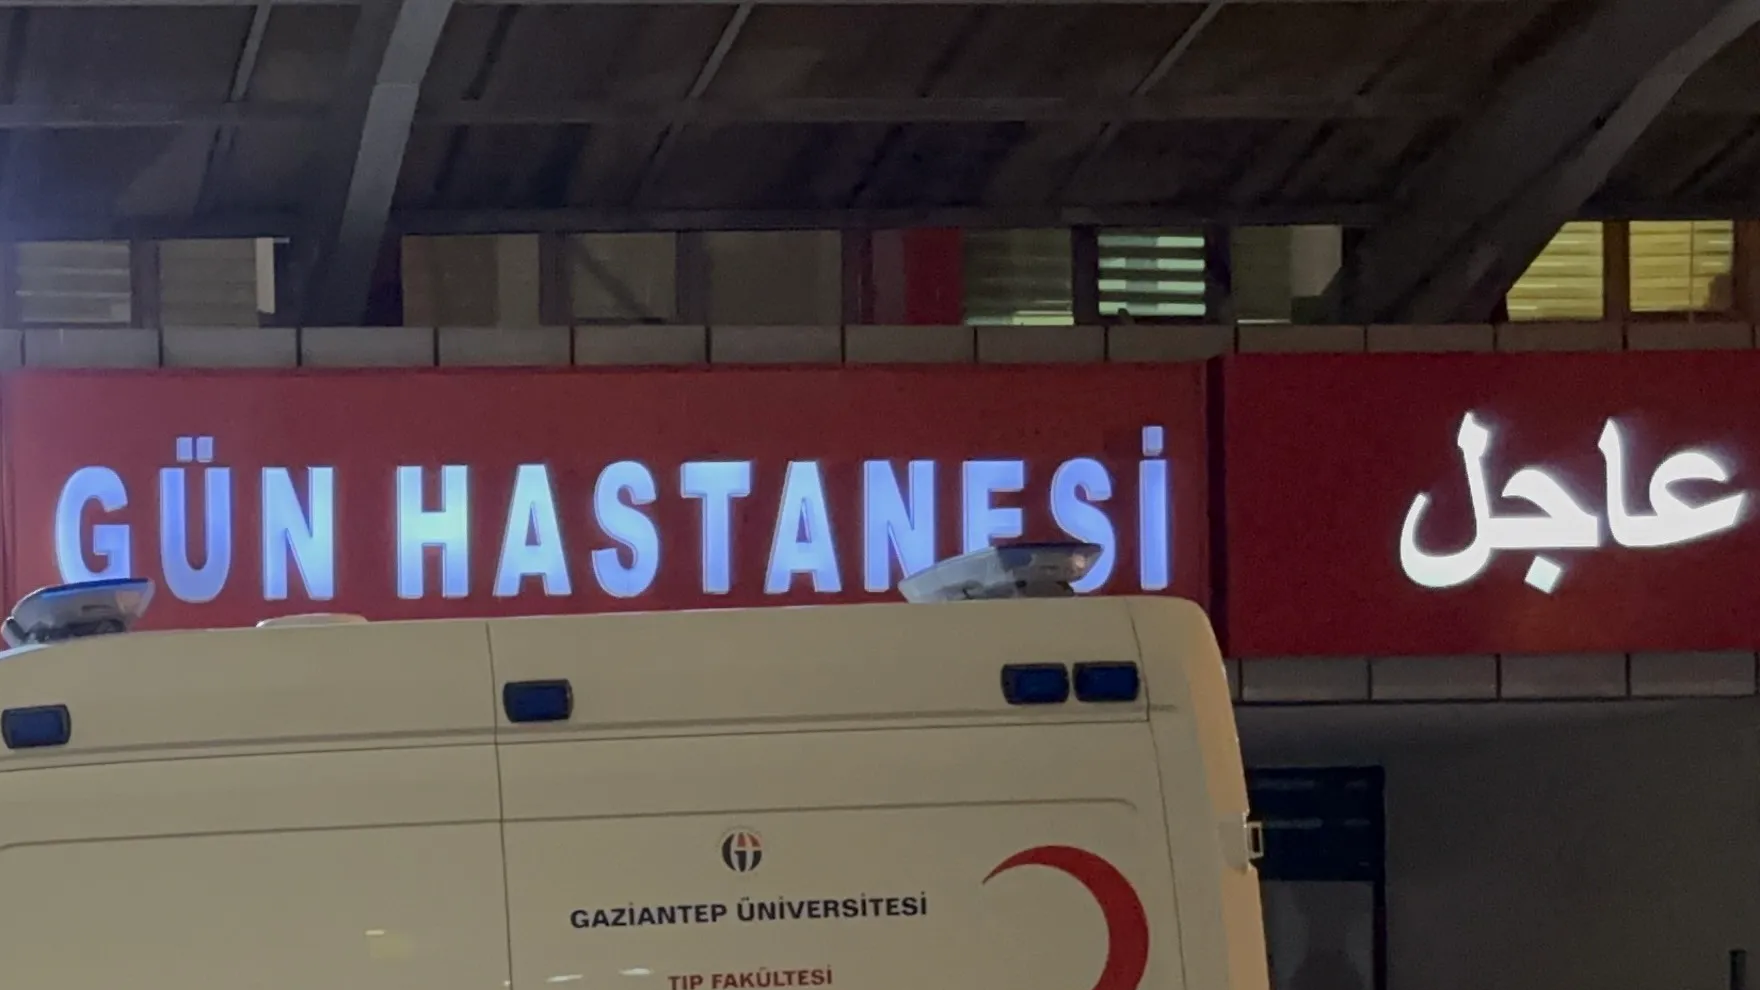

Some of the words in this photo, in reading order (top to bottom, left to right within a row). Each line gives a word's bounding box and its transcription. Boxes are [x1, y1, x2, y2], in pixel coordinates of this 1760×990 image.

[54, 436, 335, 602] GÜN
[394, 425, 1169, 601] HASTANESİ
[1398, 411, 1747, 594] عاجل
[570, 901, 728, 929] GAZİANTEP
[737, 891, 928, 922] ÜNİVERSİTESİ
[711, 964, 833, 990] FAKÜLTESİ
